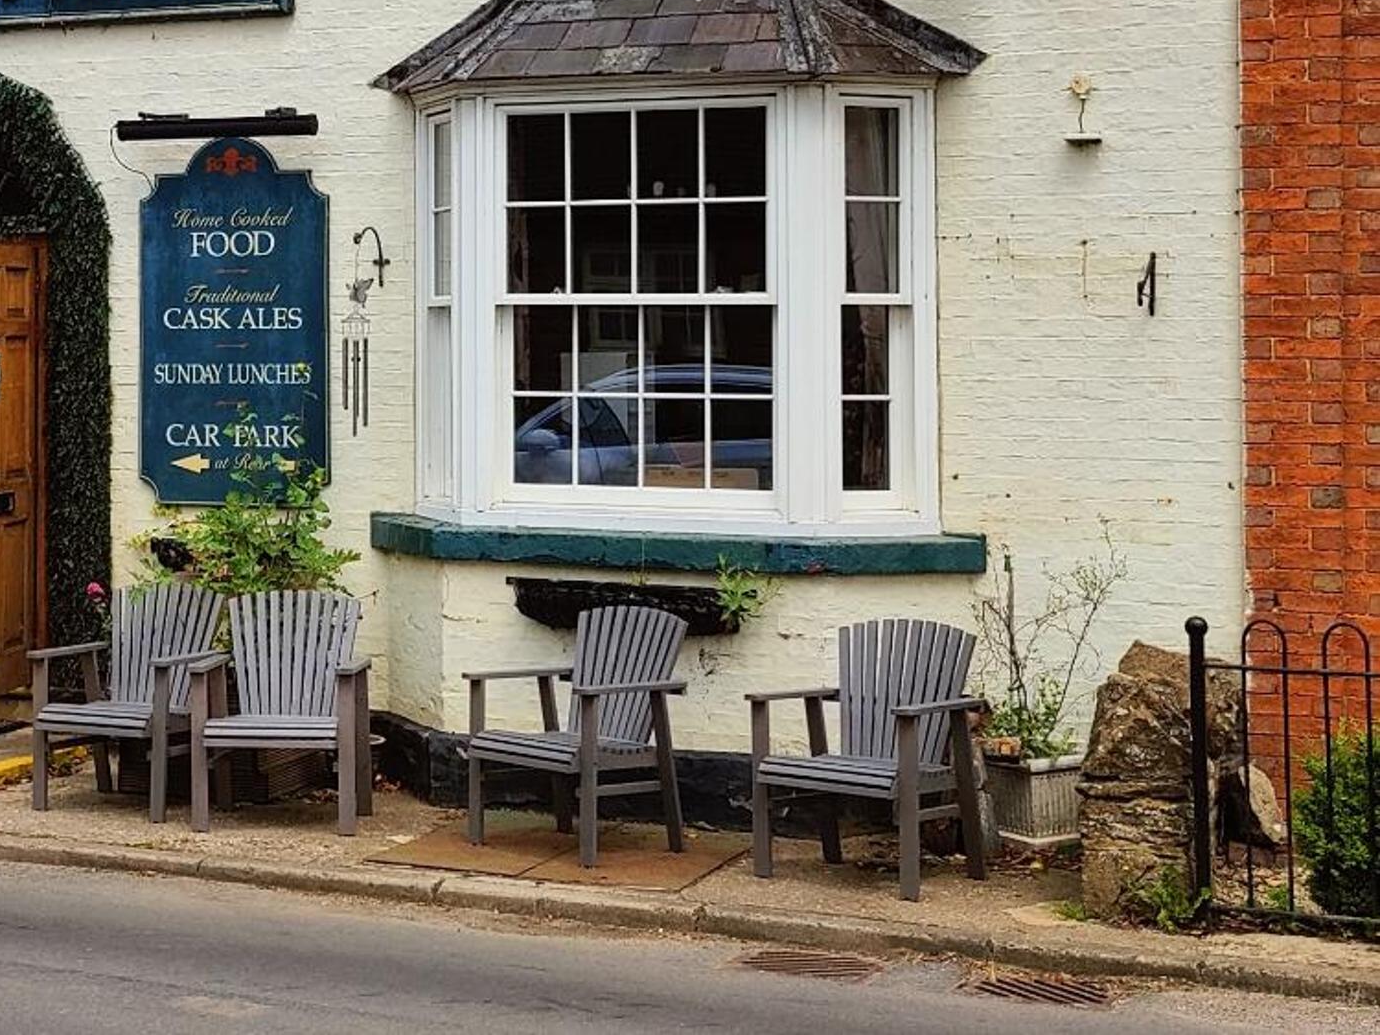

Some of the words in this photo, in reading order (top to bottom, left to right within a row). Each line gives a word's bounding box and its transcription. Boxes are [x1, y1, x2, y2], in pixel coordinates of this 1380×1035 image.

[172, 208, 224, 228] Home
[229, 207, 292, 227] Cooked
[190, 231, 275, 259] FOOD
[184, 283, 279, 304] Traditional
[163, 307, 231, 330] CASK
[238, 307, 303, 330] ALES
[154, 363, 223, 385] SUNDAY
[227, 363, 311, 385] LUNCHES
[166, 423, 220, 448] CAR
[234, 423, 302, 449] PARK
[214, 455, 229, 470] at
